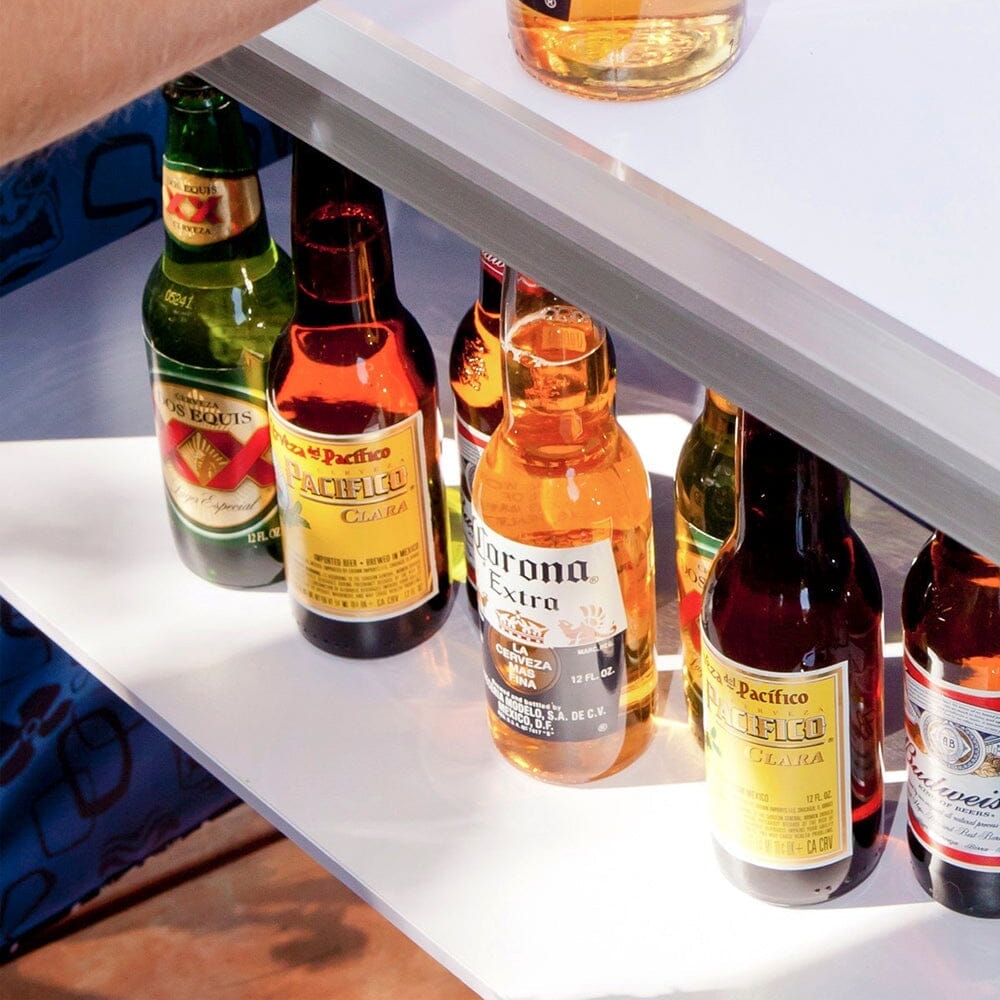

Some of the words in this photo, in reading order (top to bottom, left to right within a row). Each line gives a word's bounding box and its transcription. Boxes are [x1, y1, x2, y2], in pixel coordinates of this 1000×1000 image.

[184, 184, 217, 195] EQUIS
[175, 392, 220, 409] CERVEZA
[164, 398, 186, 417] OS
[190, 408, 252, 426] EQUIS
[284, 459, 408, 500] PACIFICO
[201, 493, 262, 515] Especial
[341, 500, 408, 524] CLARA
[248, 533, 256, 543] 12
[476, 526, 590, 584] Corona
[489, 568, 560, 611] Extra
[495, 643, 552, 671] CERVEZA
[512, 643, 528, 656] LA
[508, 661, 535, 679] MAS
[571, 675, 582, 684] 12
[585, 673, 599, 682] FL.
[600, 666, 615, 678] OZ.
[508, 673, 537, 690] FINA
[736, 680, 809, 705] Pacífico
[505, 696, 545, 721] MODELO,
[547, 710, 568, 721] S.A.
[571, 711, 585, 721] DE
[587, 706, 607, 719] C.V.
[524, 699, 551, 710] bottled
[551, 702, 562, 711] by
[706, 679, 827, 742] PACIFICO
[498, 701, 533, 728] MEXICO,
[535, 719, 554, 731] D.F.
[749, 747, 825, 767] CLARA
[806, 794, 814, 803] 12
[955, 806, 990, 817] BEERS
[807, 839, 817, 855] CA
[819, 835, 833, 853] CRV
